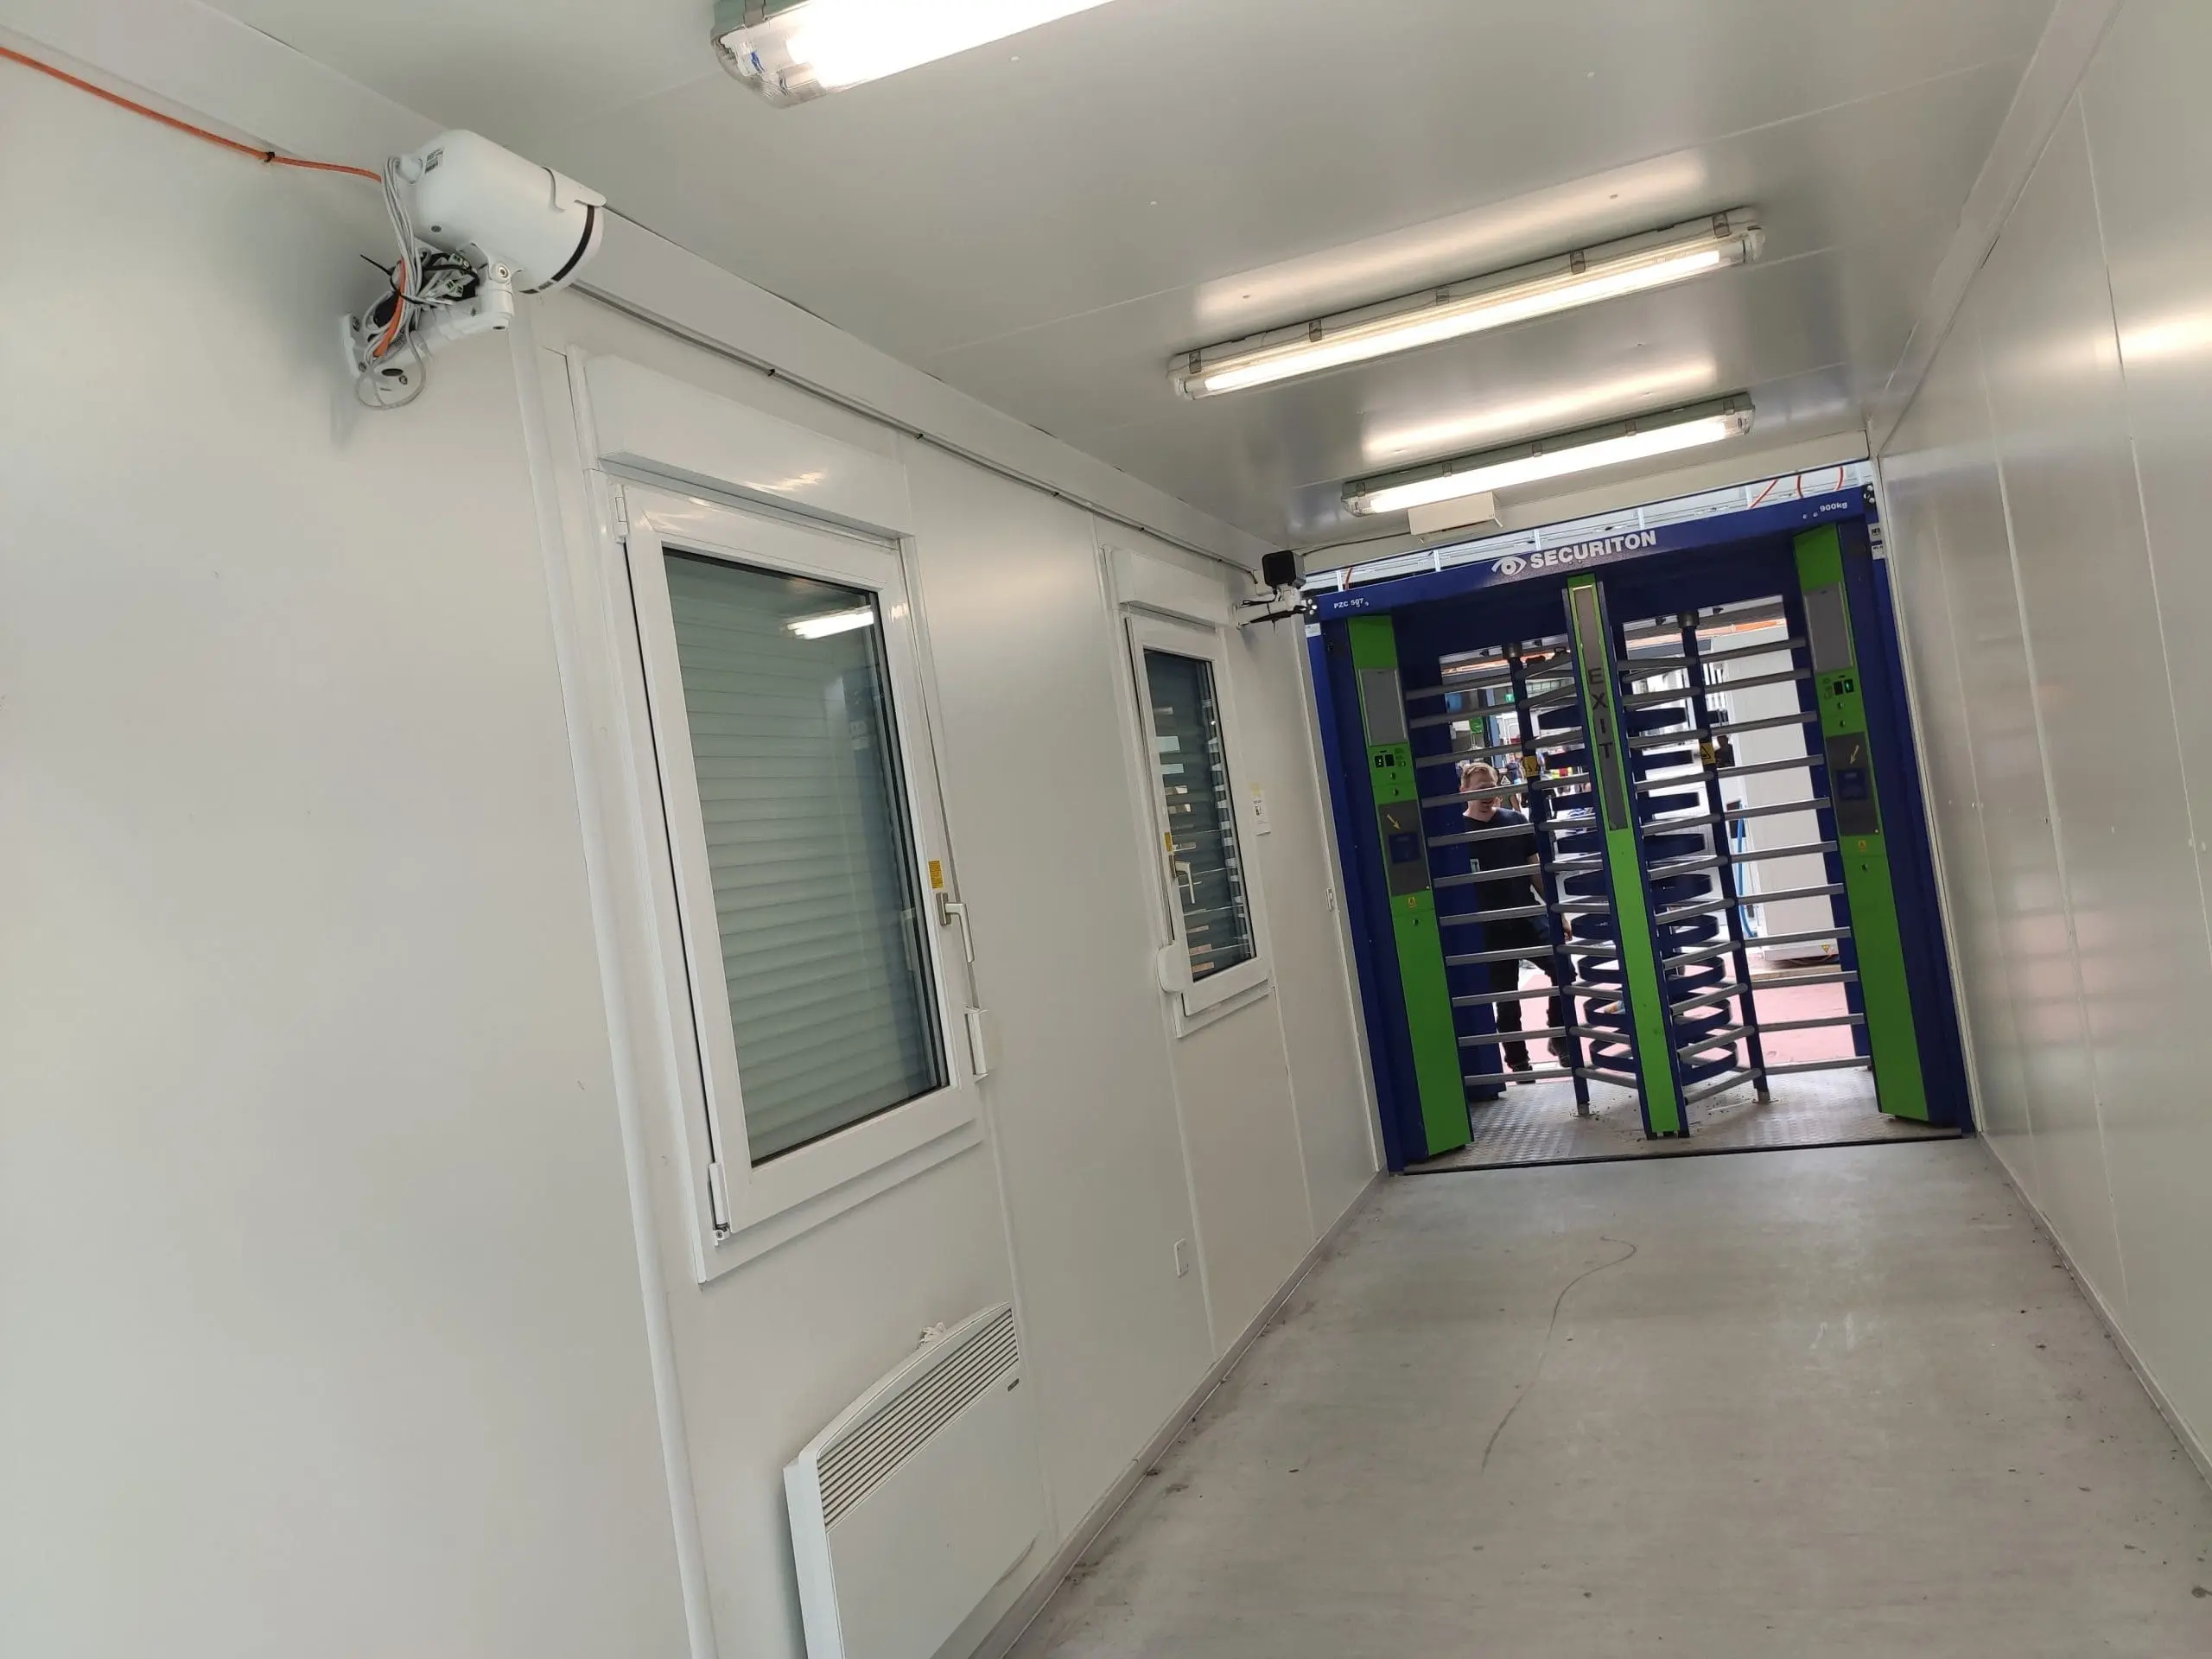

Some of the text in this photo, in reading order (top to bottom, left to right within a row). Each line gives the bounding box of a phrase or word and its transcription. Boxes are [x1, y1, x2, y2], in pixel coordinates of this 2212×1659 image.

[1820, 502, 1847, 512] 900kg
[1530, 531, 1656, 569] SECURITON
[1333, 601, 1349, 609] PZC
[1588, 667, 1615, 758] EXIT
